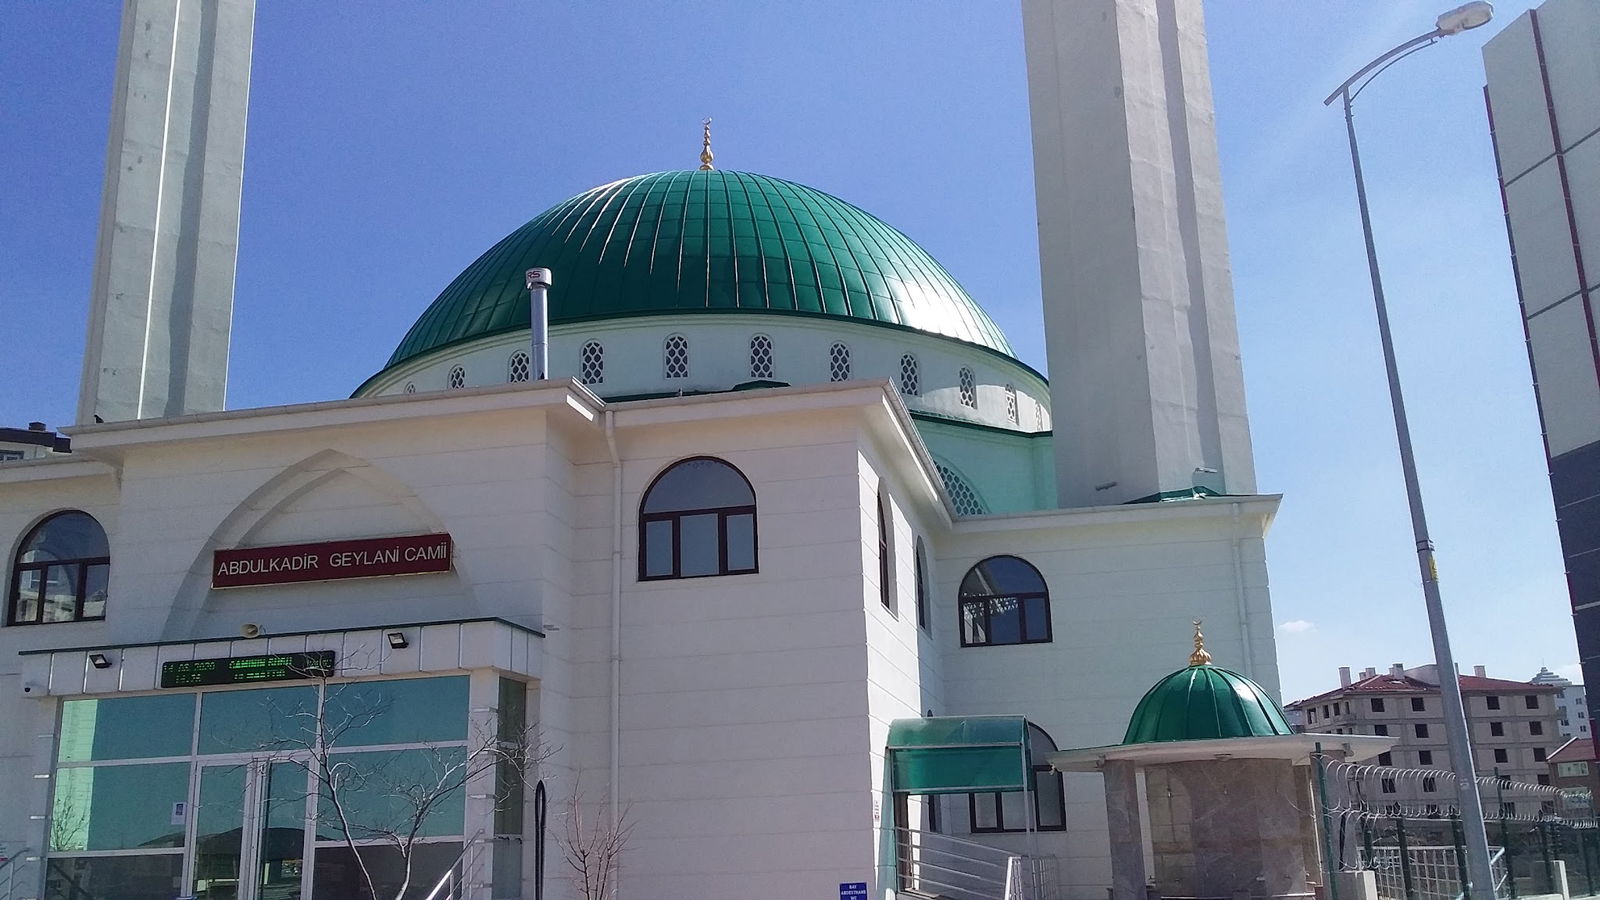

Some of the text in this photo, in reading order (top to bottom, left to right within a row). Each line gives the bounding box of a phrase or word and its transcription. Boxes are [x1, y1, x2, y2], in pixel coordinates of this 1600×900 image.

[217, 542, 447, 576] ABDULKADİR GEYLANİ CAMİİ
